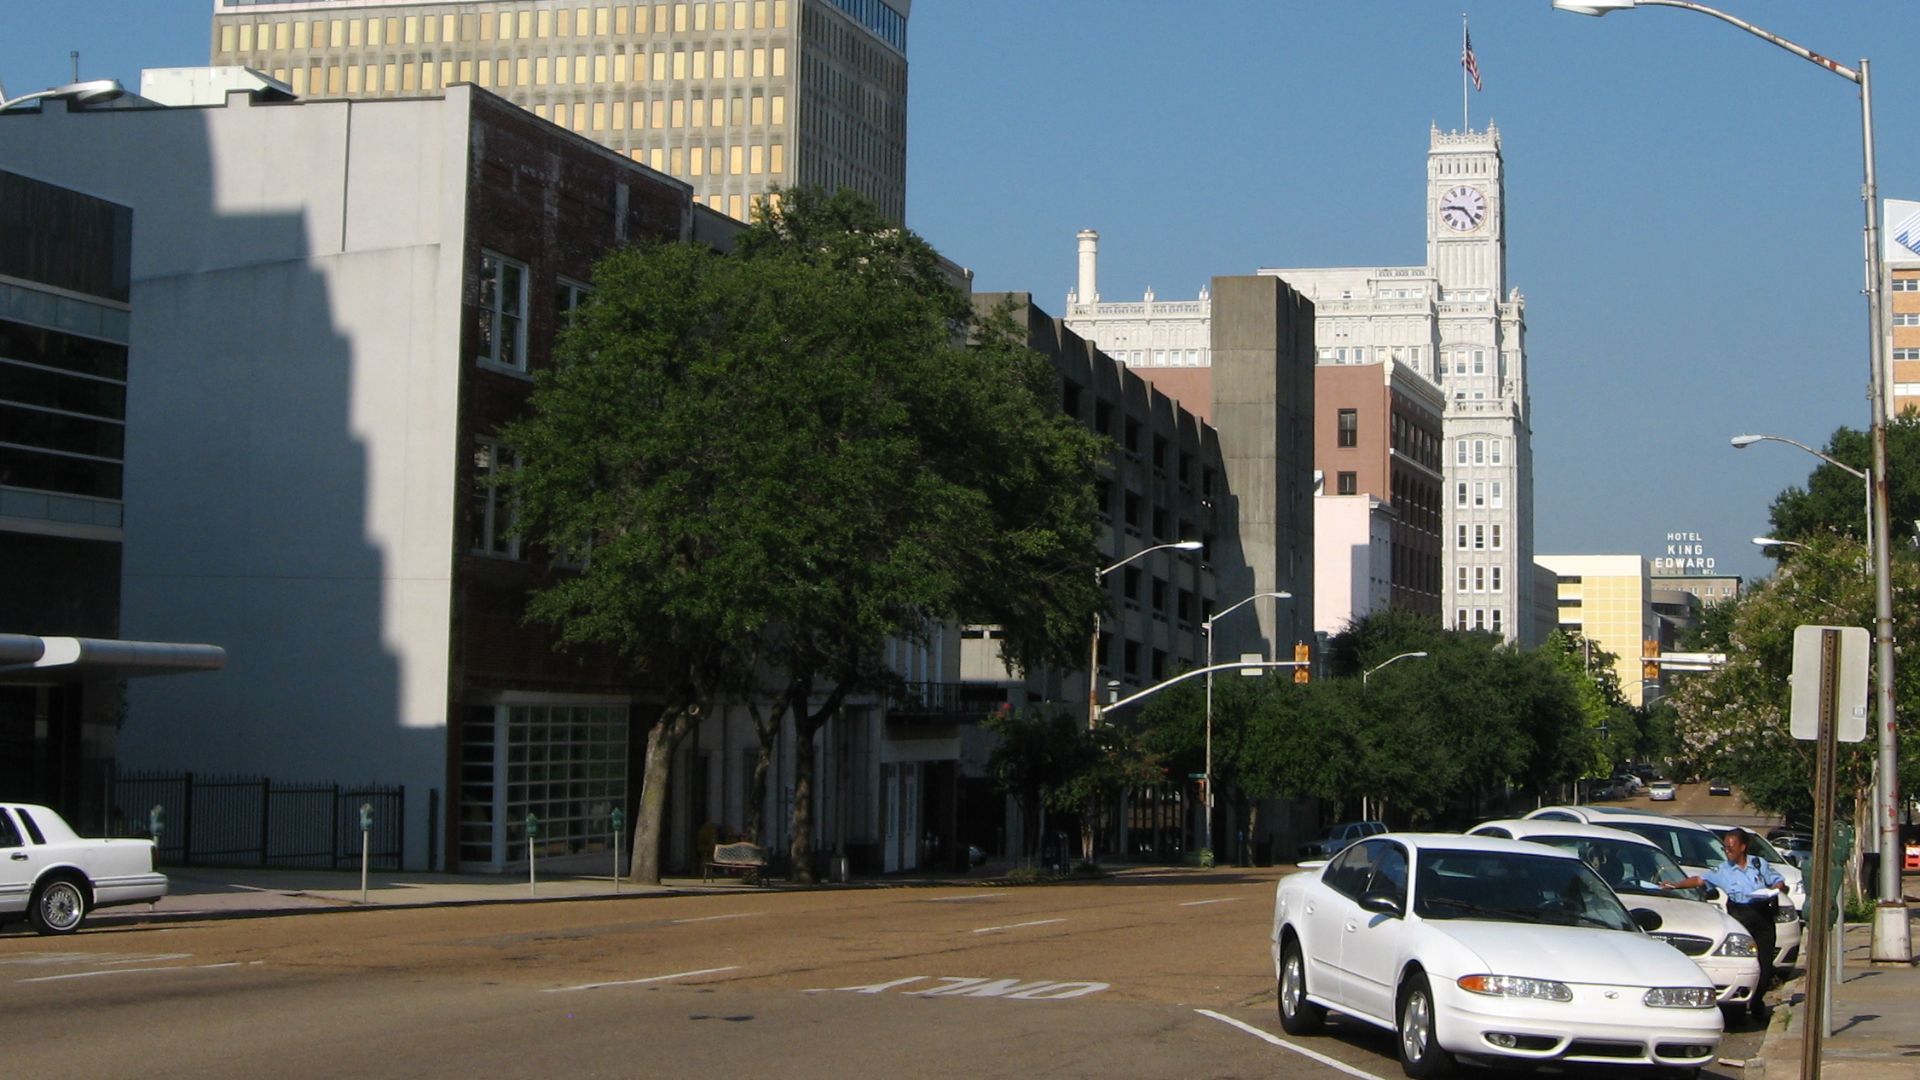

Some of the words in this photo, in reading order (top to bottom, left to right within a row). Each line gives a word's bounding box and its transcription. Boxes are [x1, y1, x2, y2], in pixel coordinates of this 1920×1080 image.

[1667, 532, 1702, 541] HOTEL
[1667, 544, 1703, 555] KING
[1655, 557, 1715, 568] EDWARD
[801, 976, 1110, 999] ONLY
